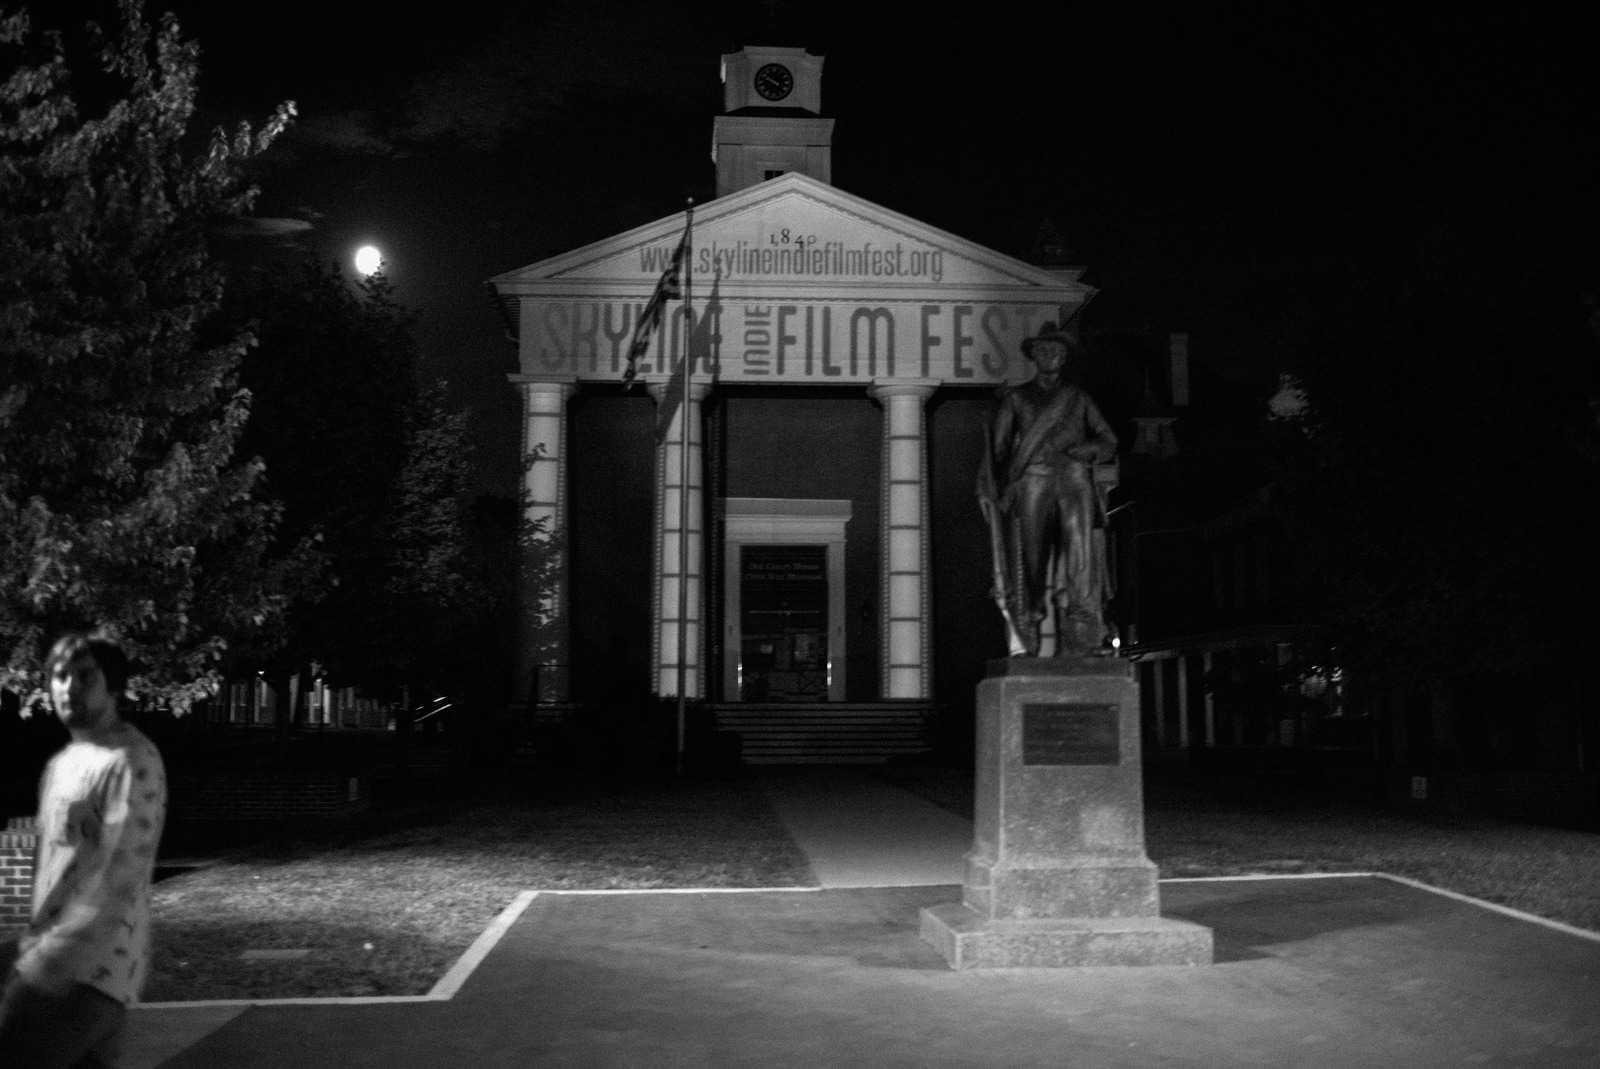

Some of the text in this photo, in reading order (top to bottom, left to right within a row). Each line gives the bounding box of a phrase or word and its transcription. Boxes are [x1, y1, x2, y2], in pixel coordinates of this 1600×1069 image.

[769, 228, 817, 249] 1840
[640, 241, 943, 282] ww.skylineindiefilmfest.org
[743, 305, 771, 375] INDIE
[777, 305, 895, 377] FILM
[921, 305, 1038, 378] FEST
